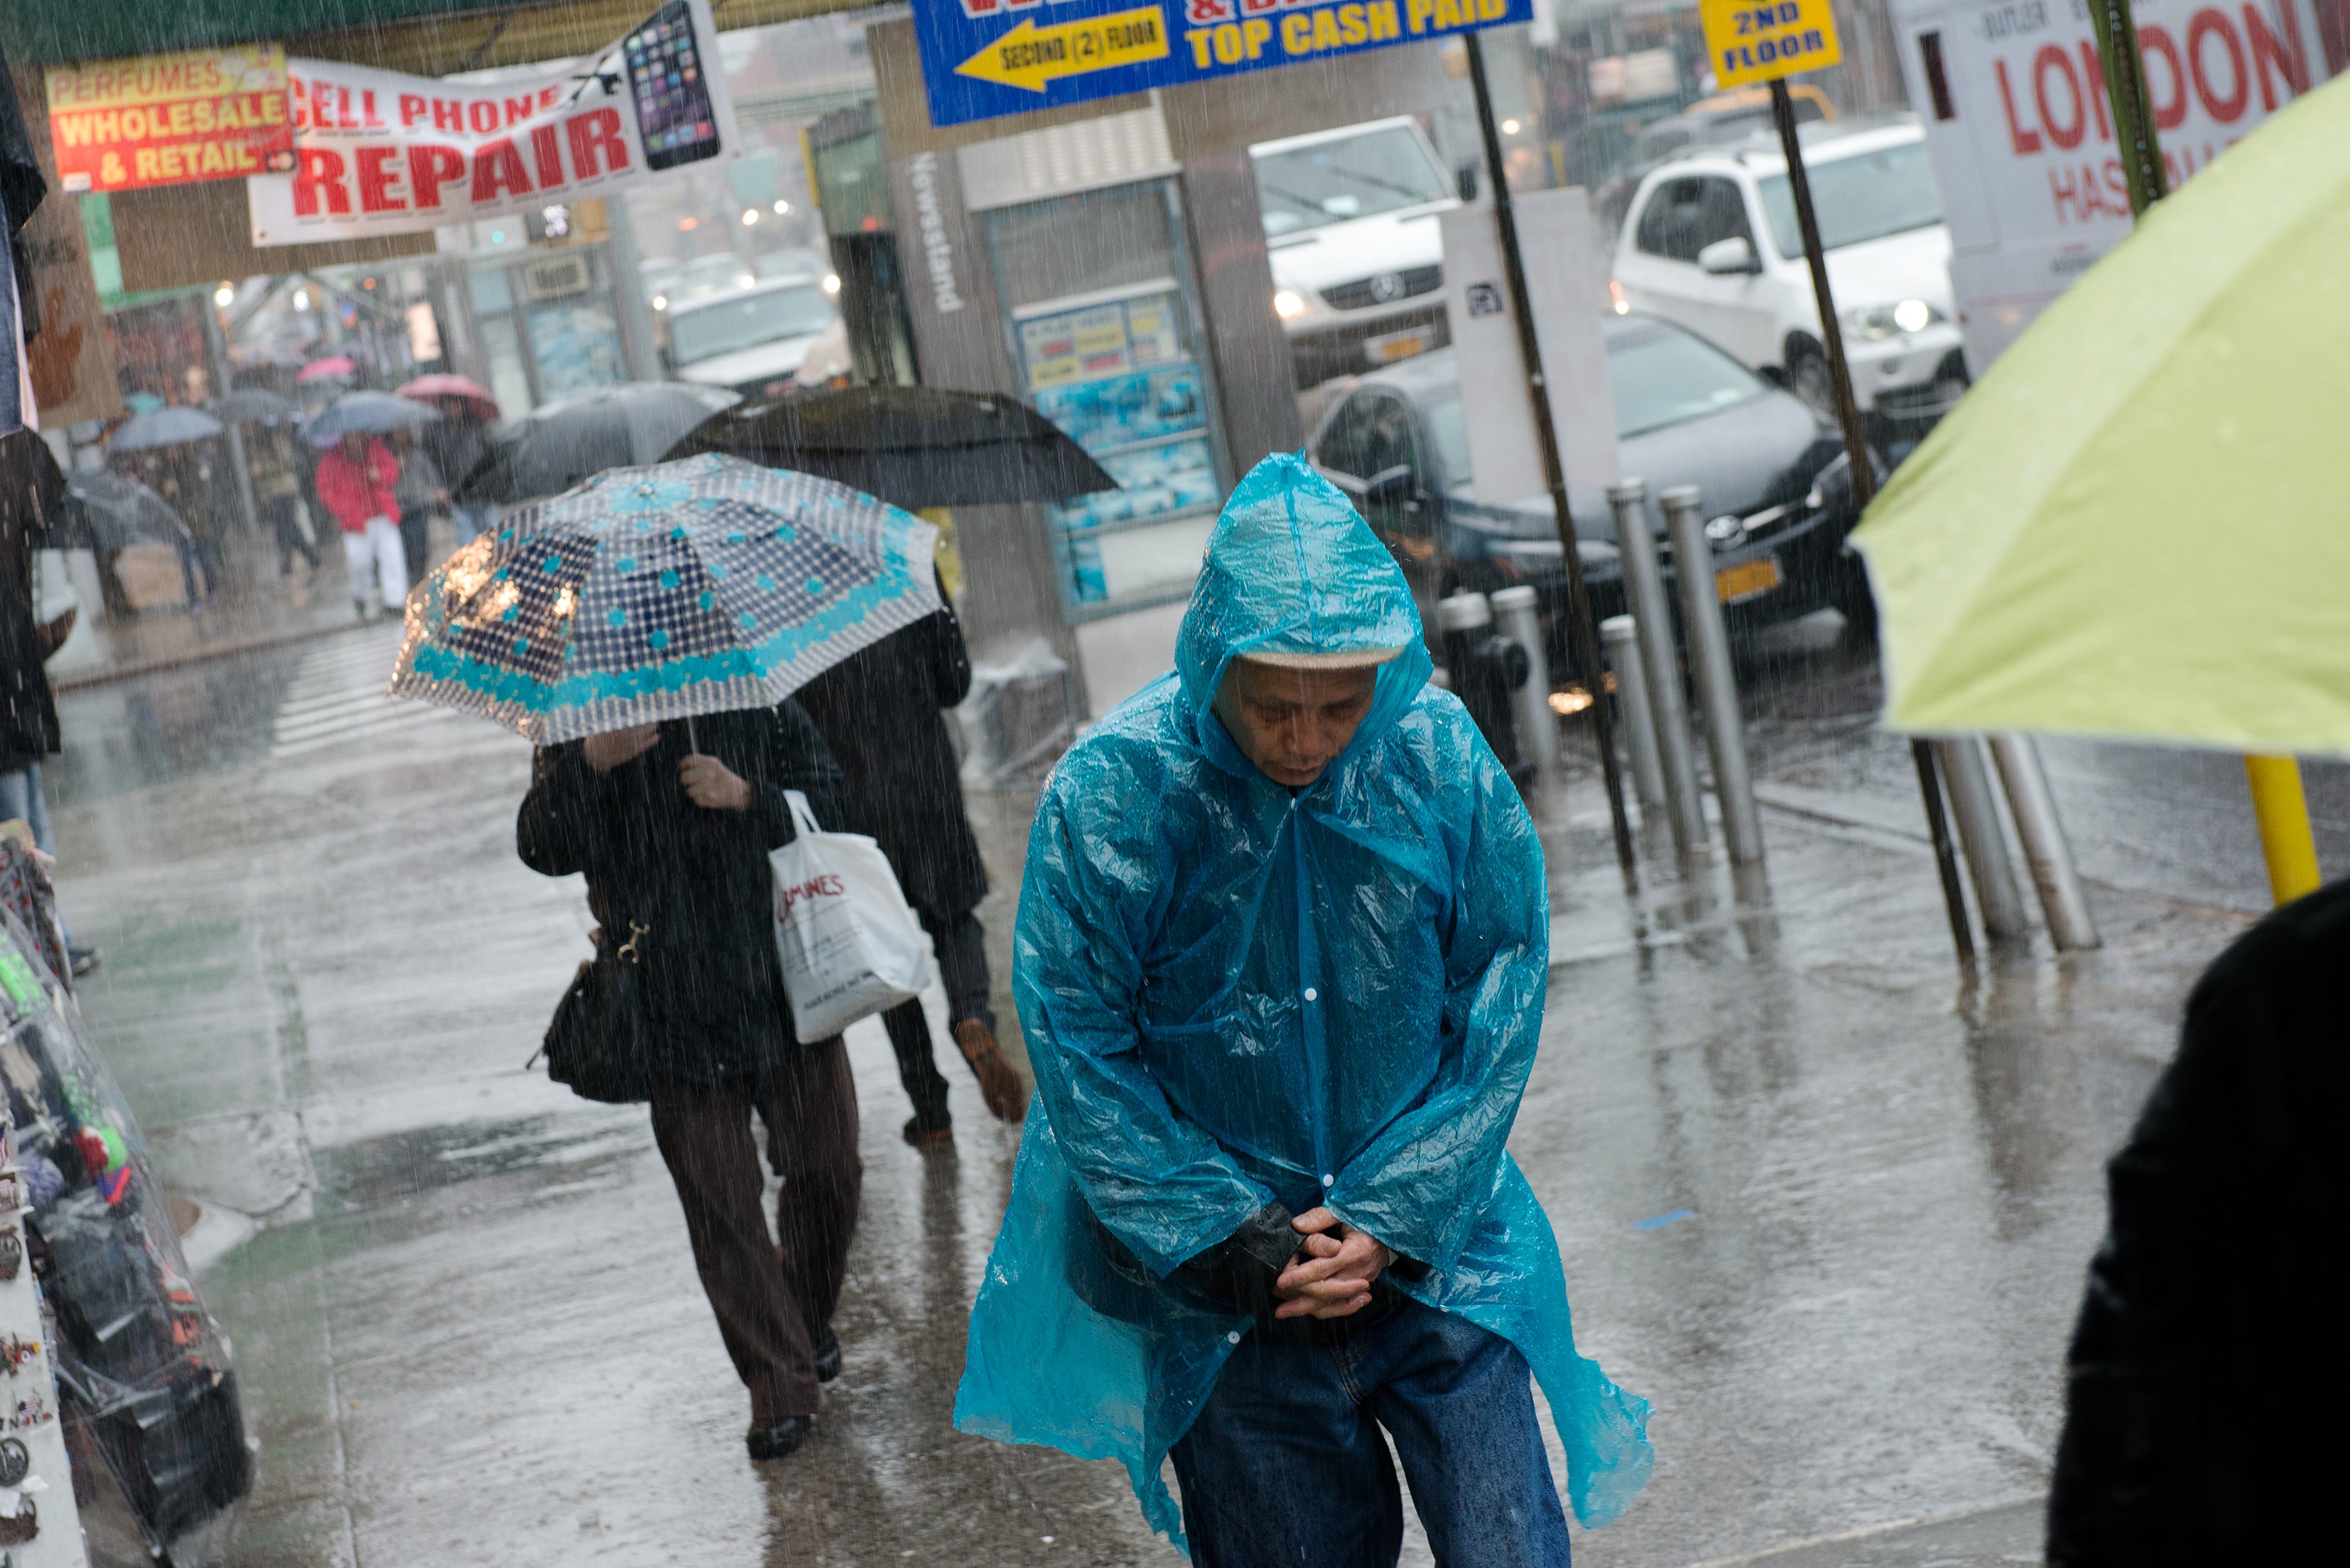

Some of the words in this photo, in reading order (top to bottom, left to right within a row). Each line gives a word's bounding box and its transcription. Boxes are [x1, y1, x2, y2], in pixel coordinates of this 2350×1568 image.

[1184, 18, 1271, 69] TOP
[1280, 2, 1401, 56] CASH
[1407, 0, 1508, 34] PAID
[1734, 2, 1799, 34] 2ND
[1000, 37, 1066, 70] SECOND
[1070, 30, 1104, 64] (2)
[1106, 20, 1158, 51] FLOOR
[1725, 30, 1823, 71] FLOOR
[53, 60, 221, 103] PERFUMES
[1994, 0, 2312, 155] LONDON
[58, 92, 284, 147] WHOLESALE
[399, 83, 559, 135] PHONE
[100, 151, 127, 184] &
[136, 140, 258, 182] RETAIL
[293, 107, 630, 216] REPAIR
[913, 151, 964, 313] Newsstand
